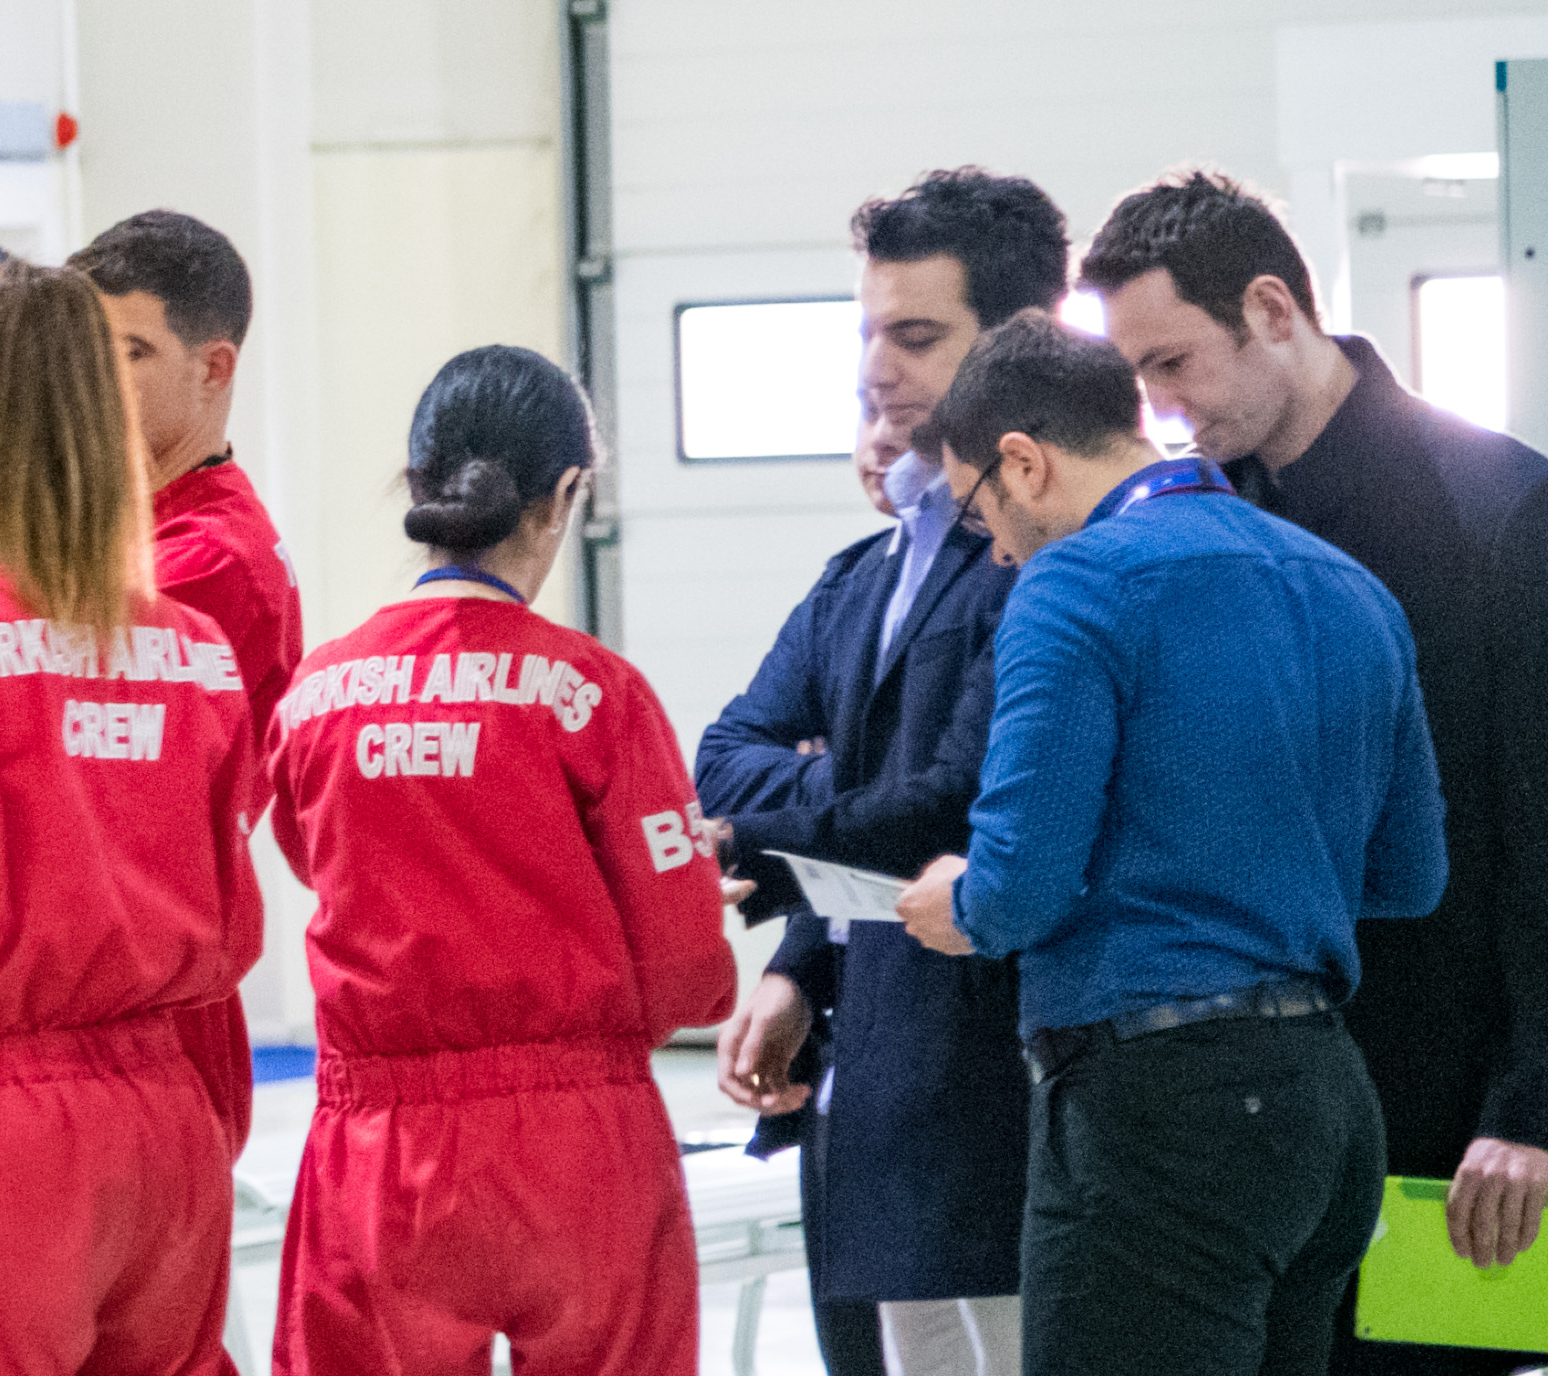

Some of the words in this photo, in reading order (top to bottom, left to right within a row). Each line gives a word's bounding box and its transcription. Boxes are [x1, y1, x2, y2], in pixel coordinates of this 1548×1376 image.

[107, 624, 244, 691] AIRLINE
[278, 655, 416, 738] TURKISH
[420, 652, 603, 733] AIRLINES
[61, 699, 167, 761] CREW
[355, 721, 481, 779] CREW
